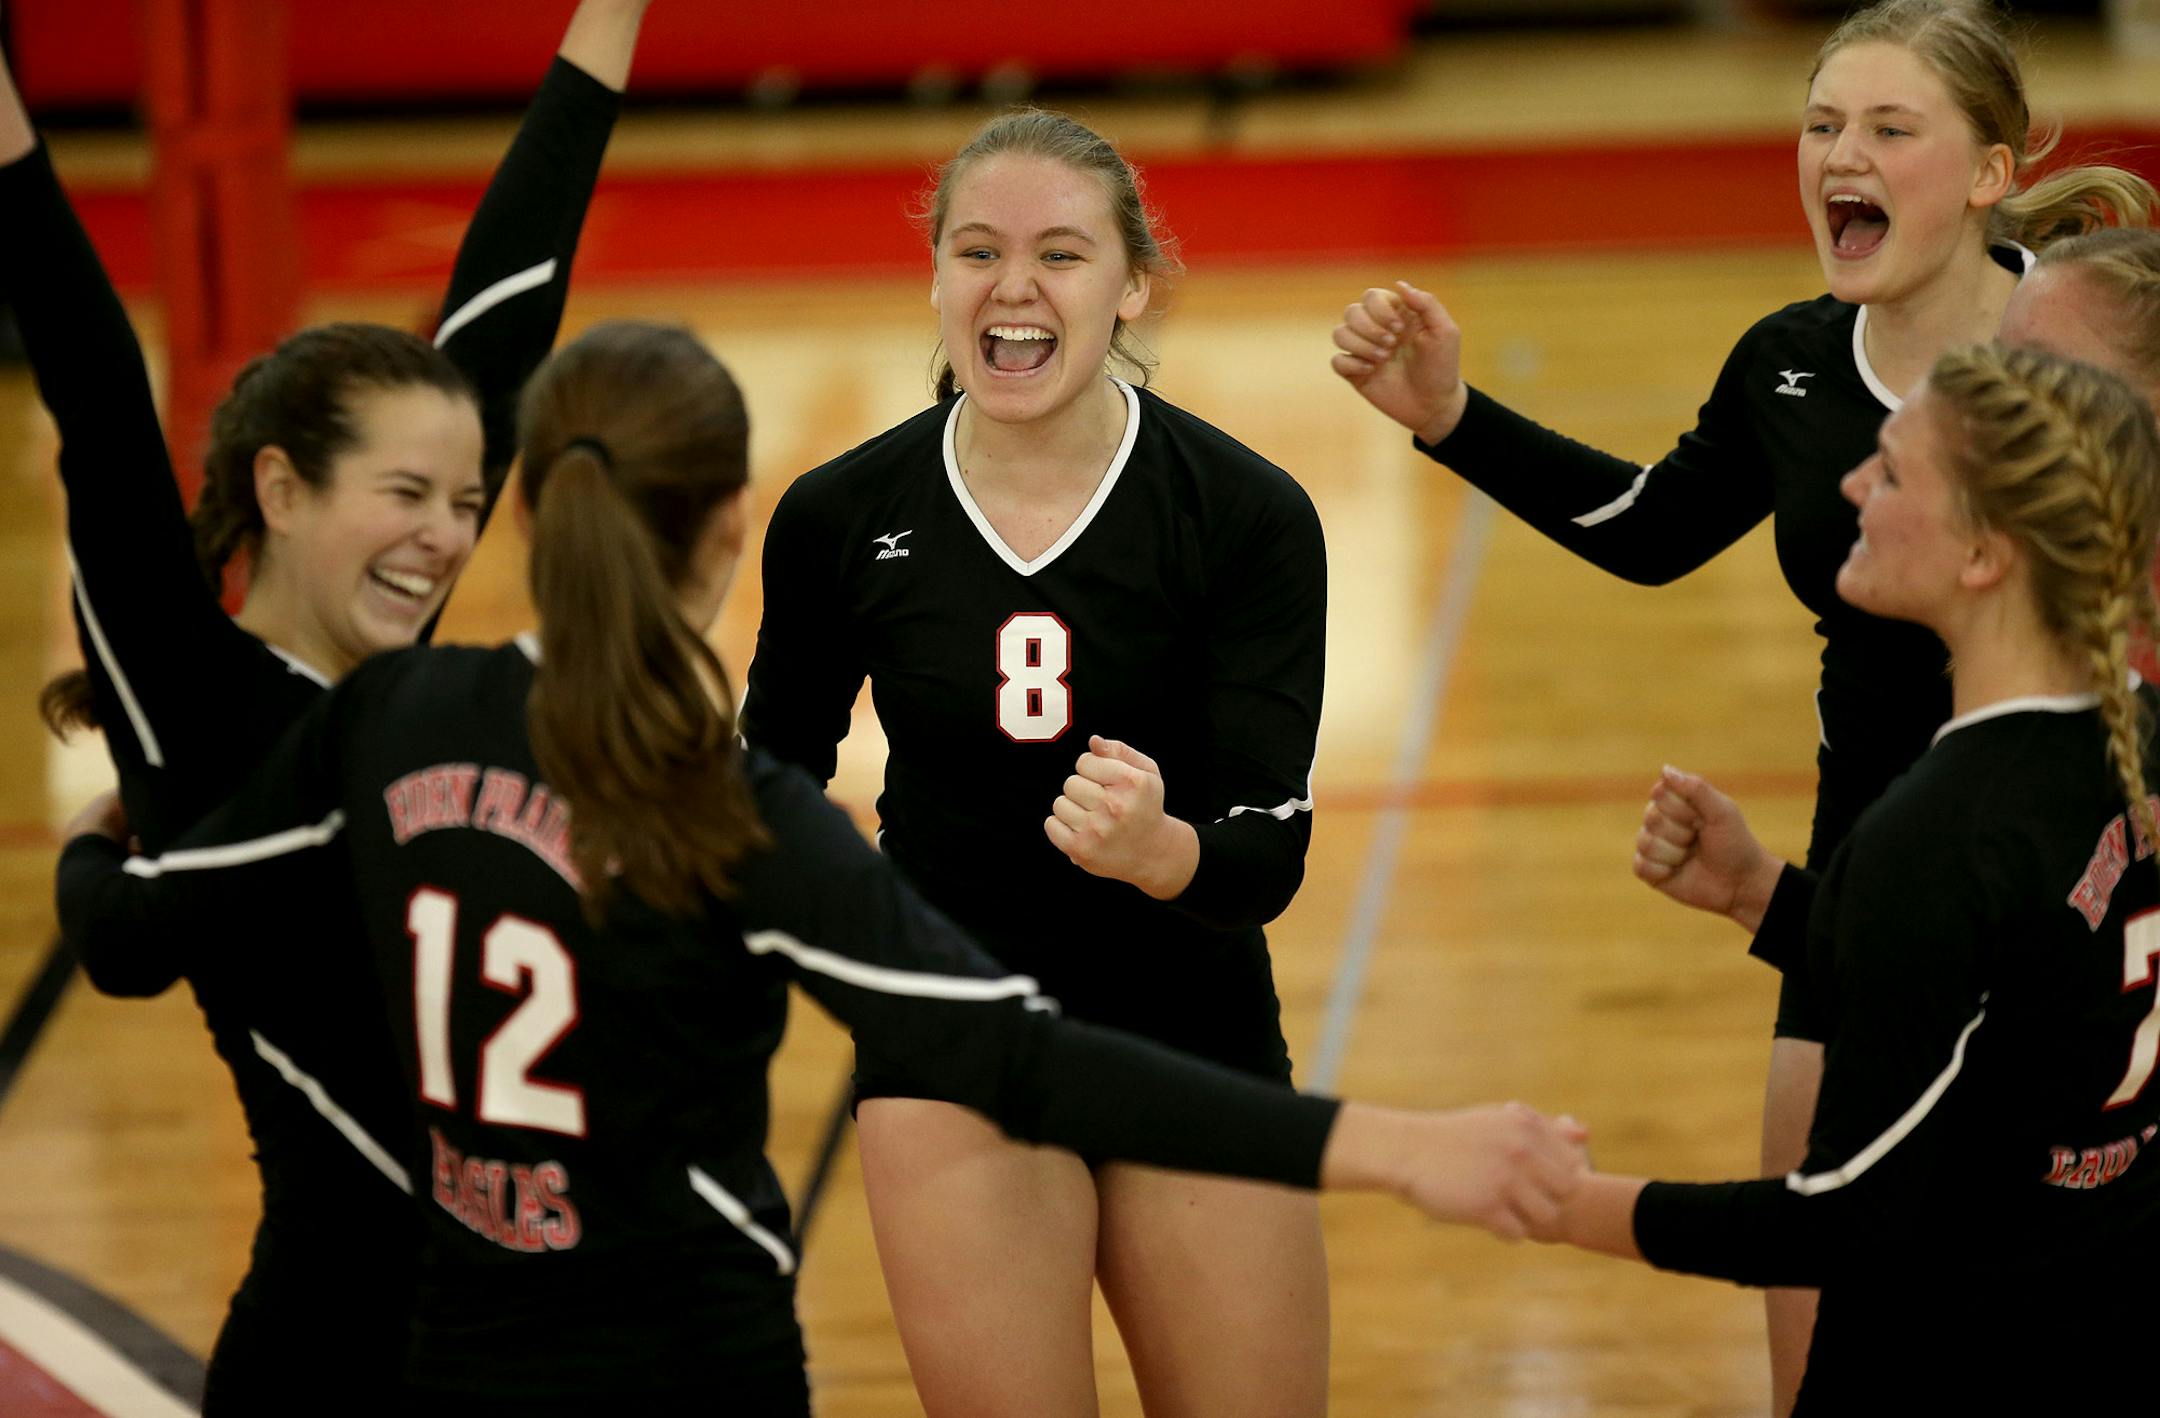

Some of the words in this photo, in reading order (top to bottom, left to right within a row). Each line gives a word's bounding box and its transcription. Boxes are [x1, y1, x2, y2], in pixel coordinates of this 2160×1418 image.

[995, 611, 1073, 743] 8
[383, 761, 481, 846] EDEN
[404, 883, 589, 1139] 12
[2101, 903, 2160, 1112] 7
[428, 1125, 582, 1253] EAGLES
